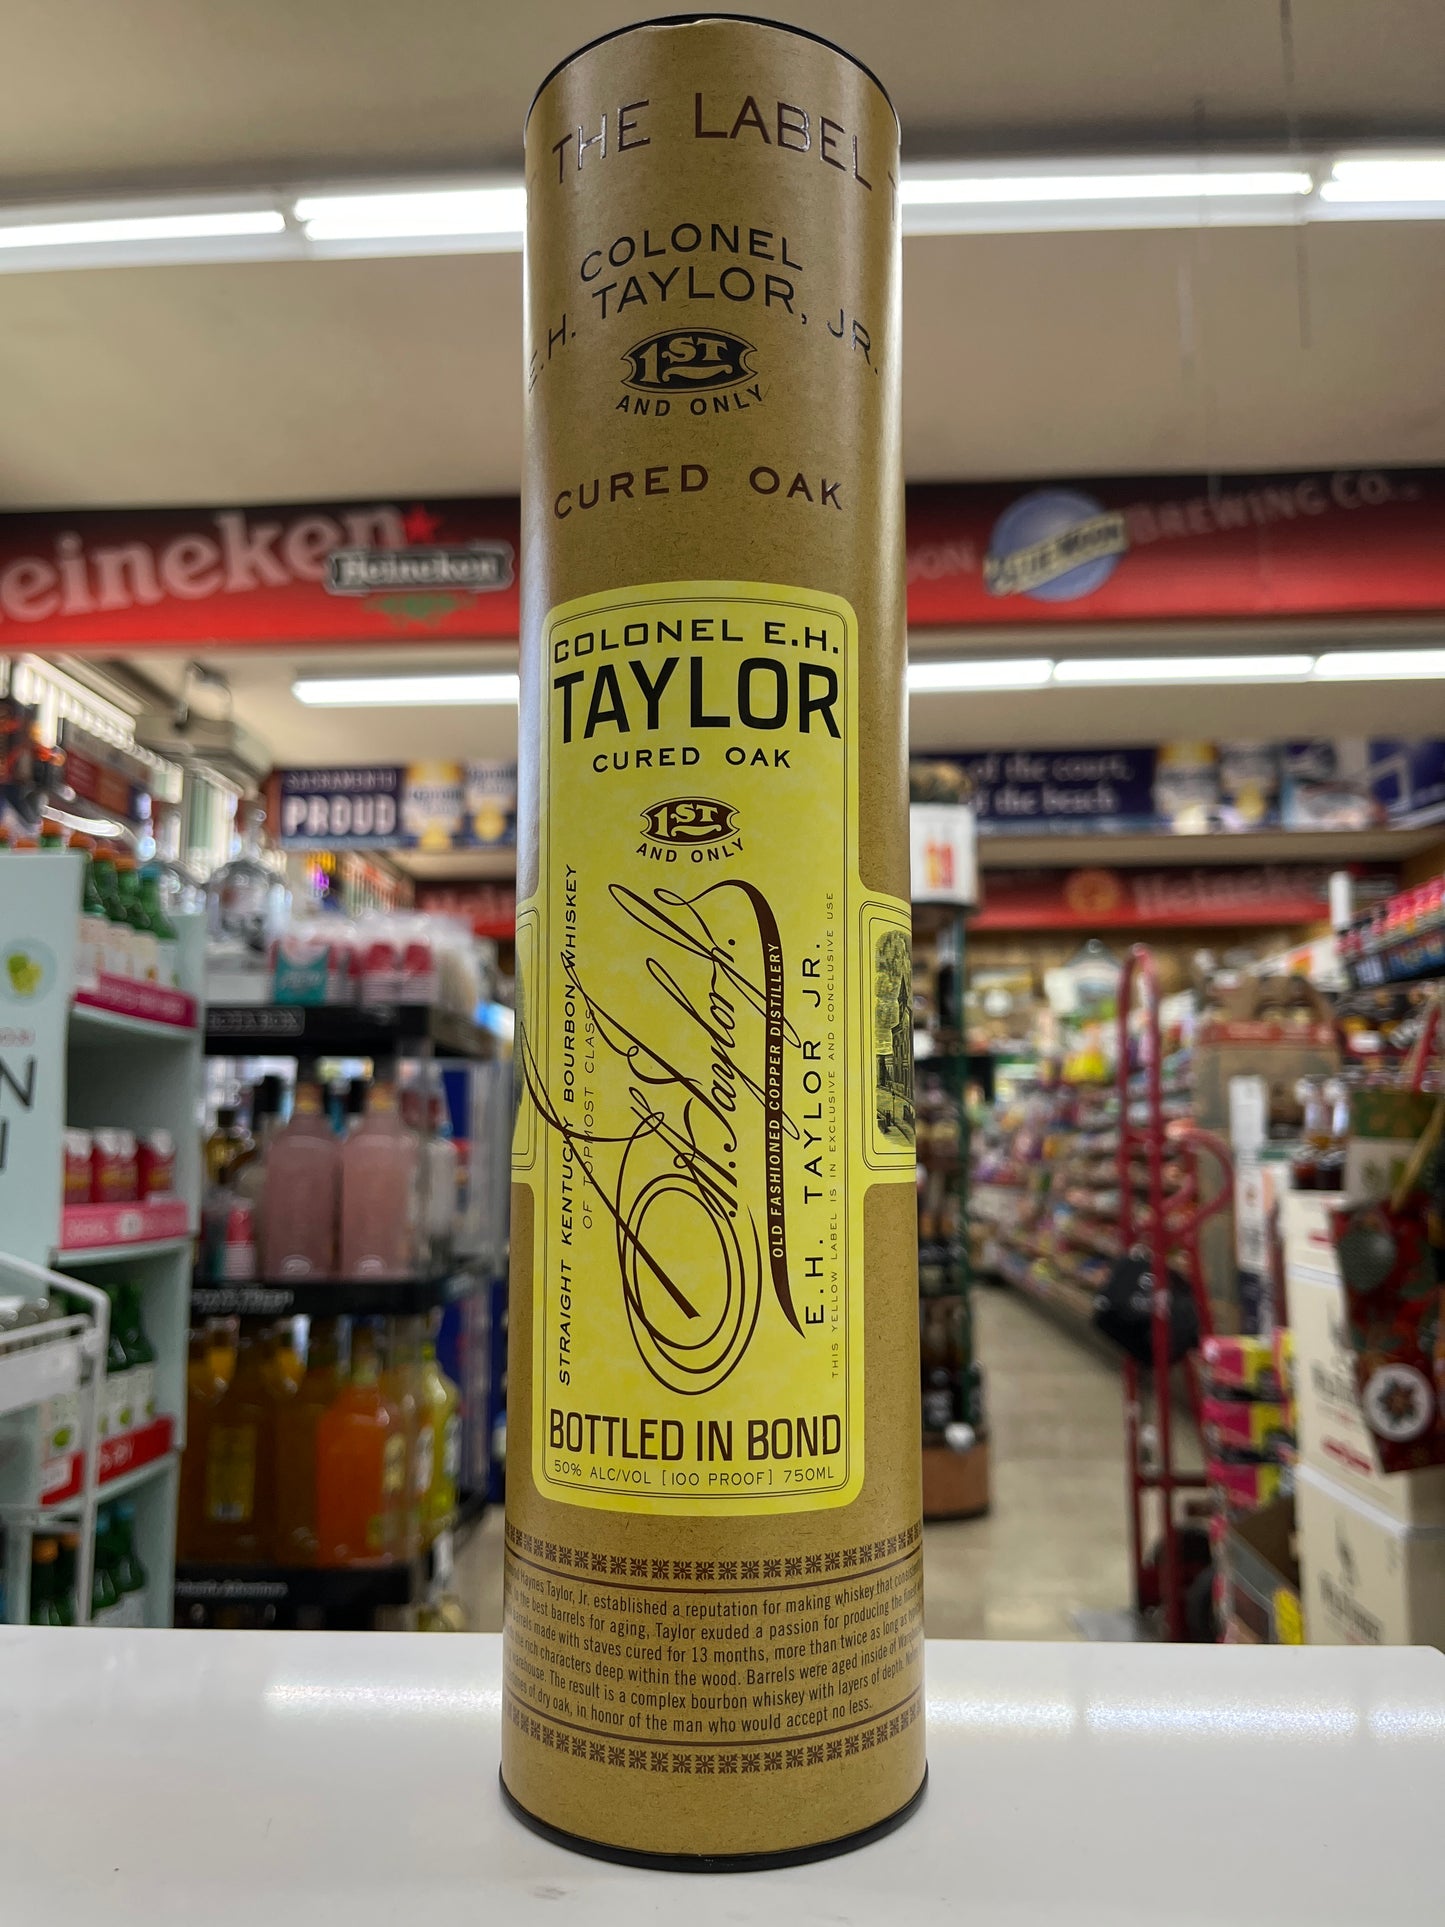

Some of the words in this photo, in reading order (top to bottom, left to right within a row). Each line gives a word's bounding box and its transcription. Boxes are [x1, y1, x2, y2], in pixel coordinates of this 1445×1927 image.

[552, 100, 651, 184] THE
[695, 93, 872, 191] LABEL
[581, 223, 803, 283] COLONEL
[592, 266, 808, 326] TAYLOR,
[827, 308, 878, 374] JR.
[637, 335, 731, 383] 1ST
[615, 394, 671, 417] AND
[689, 384, 764, 417] ONLY
[554, 464, 708, 520] CURED
[749, 466, 843, 510] OAK
[1128, 480, 1328, 544] BREWING
[0, 505, 406, 623] eineken
[554, 619, 743, 664] COLONEL
[764, 621, 839, 654] E.H.
[554, 656, 842, 745] TAYLOR
[592, 747, 700, 773] CURED
[725, 746, 791, 769] OAK
[283, 793, 397, 837] PROUD
[652, 803, 719, 838] 1ST
[636, 842, 678, 863] AND
[690, 838, 744, 863] ONLY
[565, 864, 577, 969] WHISKEY
[826, 892, 834, 920] USE
[768, 943, 782, 1037] DISTILLERY
[802, 944, 821, 1008] JR.
[826, 930, 835, 1022] CONCLUSIVE
[563, 984, 576, 1102] BOURBON
[584, 1008, 595, 1074] CLASS
[827, 1032, 835, 1061] AND
[768, 1046, 781, 1110] COPPER
[583, 1086, 595, 1187] TOPMOST
[803, 1040, 823, 1204] TAYLOR
[828, 1071, 837, 1153] EXCLUSIVE
[561, 1116, 574, 1245] KENTUCKY
[769, 1119, 782, 1216] FASHIONED
[829, 1163, 836, 1178] IN
[830, 1188, 837, 1202] IS
[583, 1201, 593, 1229] OF
[772, 1226, 784, 1258] OLD
[830, 1213, 838, 1260] LABEL
[804, 1239, 824, 1325] E.H.
[831, 1271, 839, 1332] YELLOW
[559, 1259, 572, 1386] STRAIGHT
[550, 1408, 684, 1462] BOTTLED
[696, 1420, 733, 1462] IN
[748, 1414, 841, 1460] BOND
[554, 1460, 582, 1477] 50%
[590, 1466, 652, 1485] ALC/VOL
[708, 1468, 773, 1487] PROOF]
[783, 1468, 835, 1484] 750ML
[520, 1591, 530, 1608] the
[532, 1597, 548, 1617] best
[551, 1605, 585, 1627] barrels
[590, 1614, 605, 1631] for
[610, 1620, 650, 1640] aging,
[656, 1622, 696, 1642] Taylor
[701, 1623, 749, 1640] exuded
[755, 1626, 763, 1638] a
[769, 1618, 818, 1640] passion
[824, 1614, 839, 1630] for
[843, 1602, 889, 1629] producing
[891, 1596, 902, 1611] the
[521, 1568, 544, 1595] Haynes
[547, 1580, 575, 1605] Taylor,
[578, 1589, 590, 1606] Jr.
[594, 1595, 667, 1616] established
[672, 1604, 680, 1616] a
[686, 1601, 758, 1620] reputation
[763, 1599, 781, 1615] for
[786, 1594, 831, 1613] making
[834, 1584, 875, 1606] whiskey
[876, 1577, 893, 1595] that
[513, 1608, 532, 1630] barrels
[534, 1622, 556, 1641] made
[559, 1631, 580, 1649] with
[583, 1635, 621, 1657] staves
[625, 1646, 662, 1661] cured
[667, 1646, 686, 1662] for
[692, 1647, 708, 1663] 13
[713, 1647, 769, 1663] months,
[774, 1644, 806, 1660] more
[810, 1637, 836, 1655] than
[841, 1631, 868, 1649] twice
[870, 1625, 881, 1640] as
[883, 1618, 898, 1637] long
[901, 1613, 907, 1626] as
[525, 1638, 540, 1655] rich
[540, 1647, 592, 1674] characters
[595, 1661, 624, 1683] deep
[628, 1667, 670, 1685] within
[674, 1669, 697, 1686] the
[702, 1670, 741, 1686] wood.
[747, 1666, 795, 1685] Barrels
[799, 1663, 828, 1680] were
[832, 1653, 858, 1675] aged
[861, 1643, 888, 1667] inside
[889, 1637, 897, 1652] of
[512, 1655, 547, 1683] warehouse.
[549, 1668, 566, 1689] The
[569, 1679, 600, 1700] result
[604, 1684, 615, 1702] is
[619, 1691, 626, 1703] a
[630, 1692, 686, 1711] complex
[691, 1693, 748, 1710] bourbon
[752, 1688, 805, 1709] whiskey
[809, 1682, 834, 1701] with
[838, 1674, 869, 1698] layers
[871, 1670, 880, 1685] of
[882, 1660, 904, 1681] depth.
[528, 1684, 536, 1698] of
[537, 1687, 550, 1709] dry
[552, 1697, 573, 1717] oak,
[577, 1701, 587, 1719] in
[591, 1704, 625, 1726] honor
[629, 1712, 641, 1728] of
[646, 1713, 668, 1731] the
[673, 1720, 703, 1733] man
[708, 1717, 736, 1733] who
[741, 1713, 781, 1733] would
[786, 1706, 828, 1728] accept
[832, 1705, 846, 1720] no
[849, 1696, 872, 1715] less.
